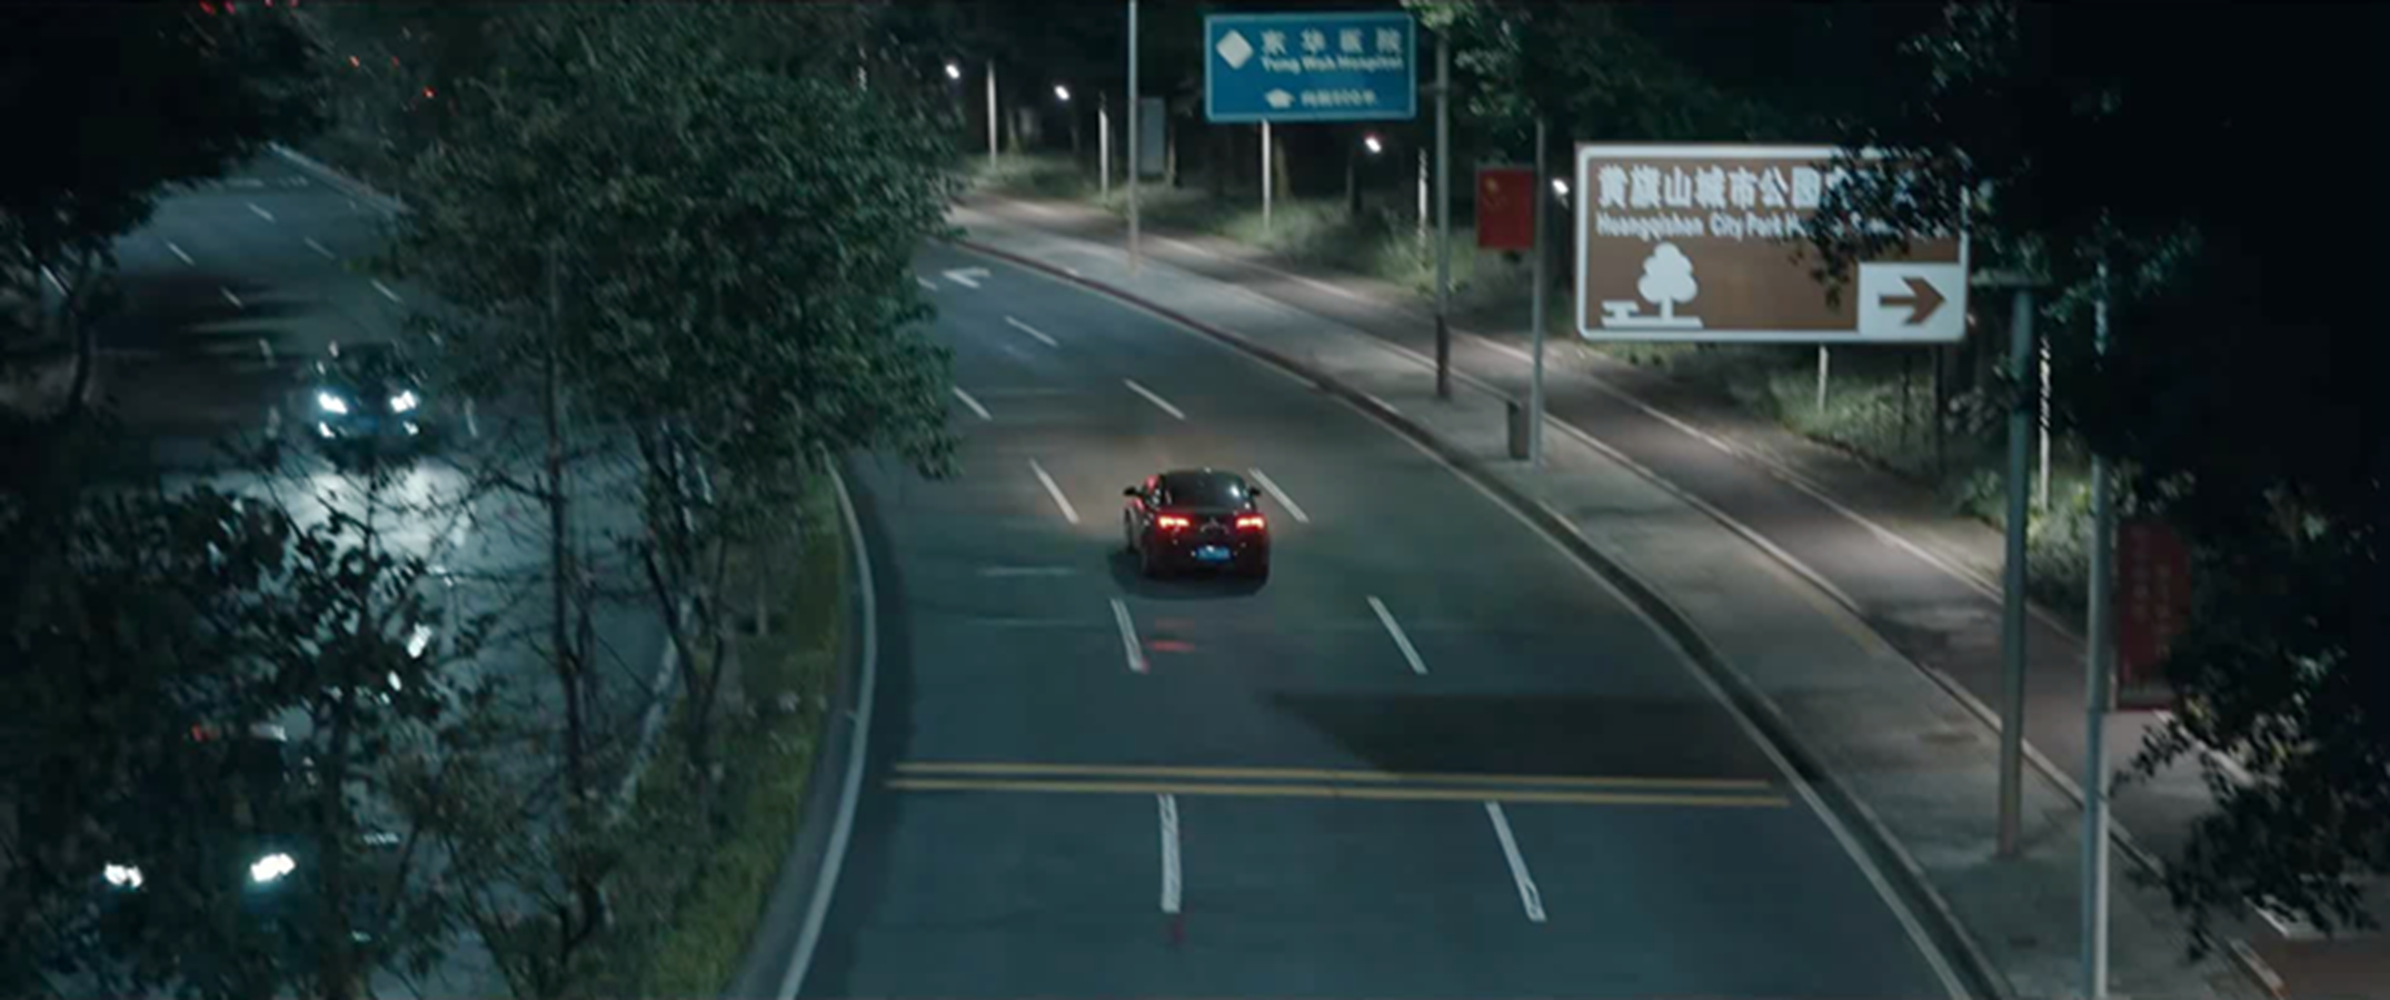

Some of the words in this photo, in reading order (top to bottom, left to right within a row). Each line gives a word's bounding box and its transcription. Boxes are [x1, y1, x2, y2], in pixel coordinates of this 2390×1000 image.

[1337, 54, 1403, 73] Hospital
[1597, 163, 1918, 210] 黄旗山城市公园
[1709, 211, 1743, 241] City
[1746, 212, 1783, 238] Park
